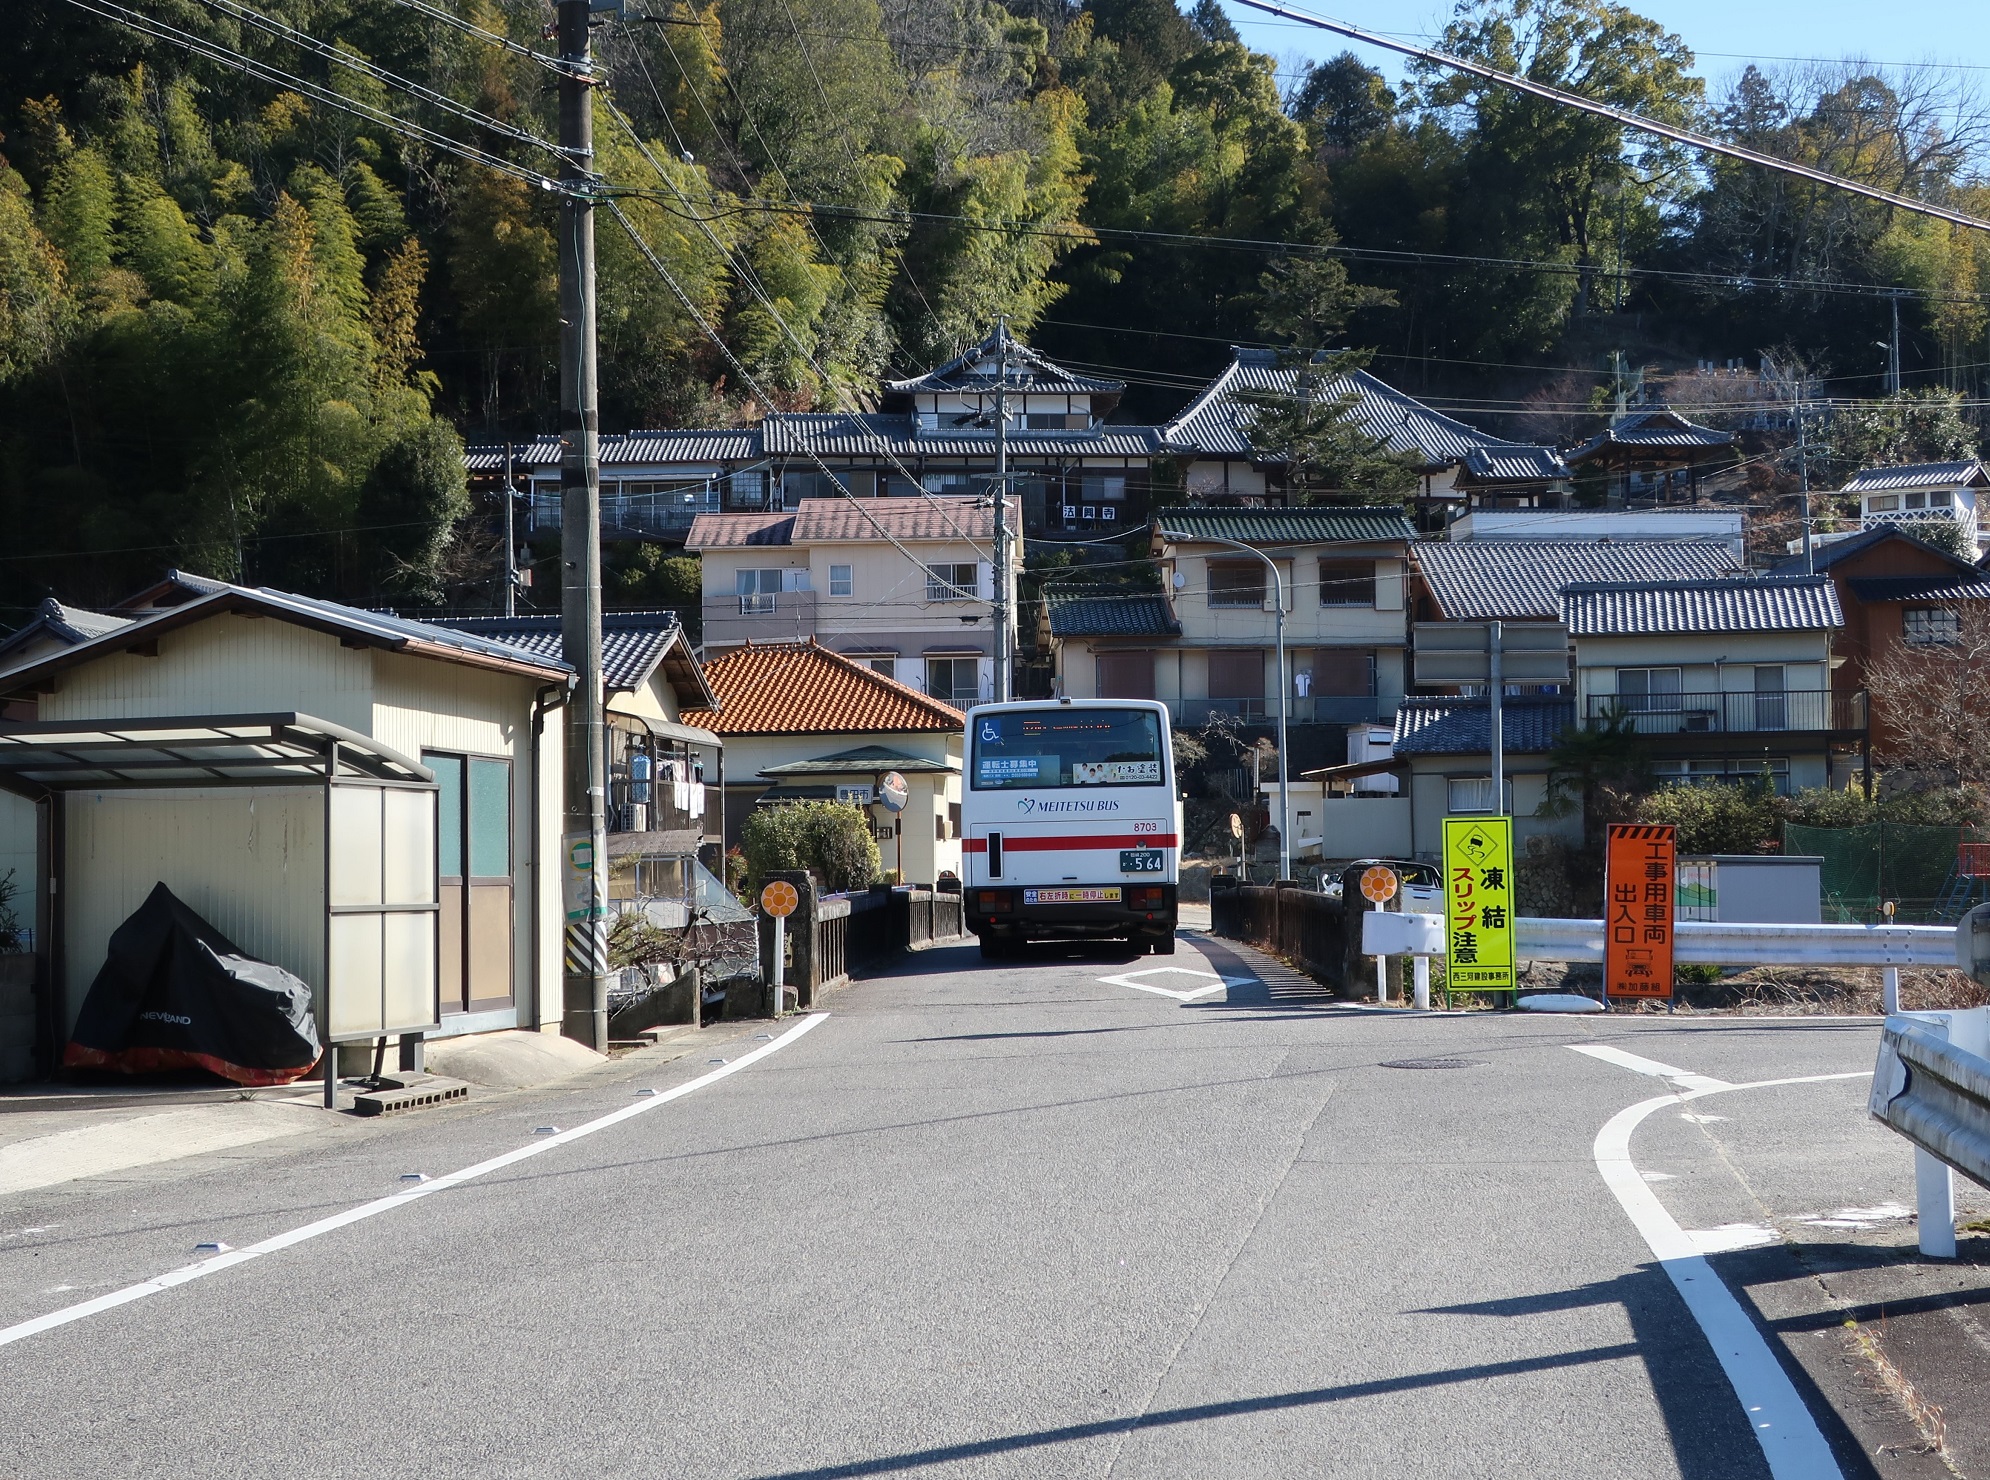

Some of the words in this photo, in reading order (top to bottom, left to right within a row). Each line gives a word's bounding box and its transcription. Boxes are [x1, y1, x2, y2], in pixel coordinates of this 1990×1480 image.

[1038, 801, 1095, 812] MEITETSU
[1097, 800, 1120, 811] BUS
[1133, 822, 1157, 832] 8703
[1452, 867, 1478, 964] スリップ注意
[1480, 866, 1506, 929] 凍結
[1613, 883, 1637, 944] 出入口
[1643, 842, 1668, 945] 工事用車両
[1453, 972, 1509, 981] 西三河建設事務所
